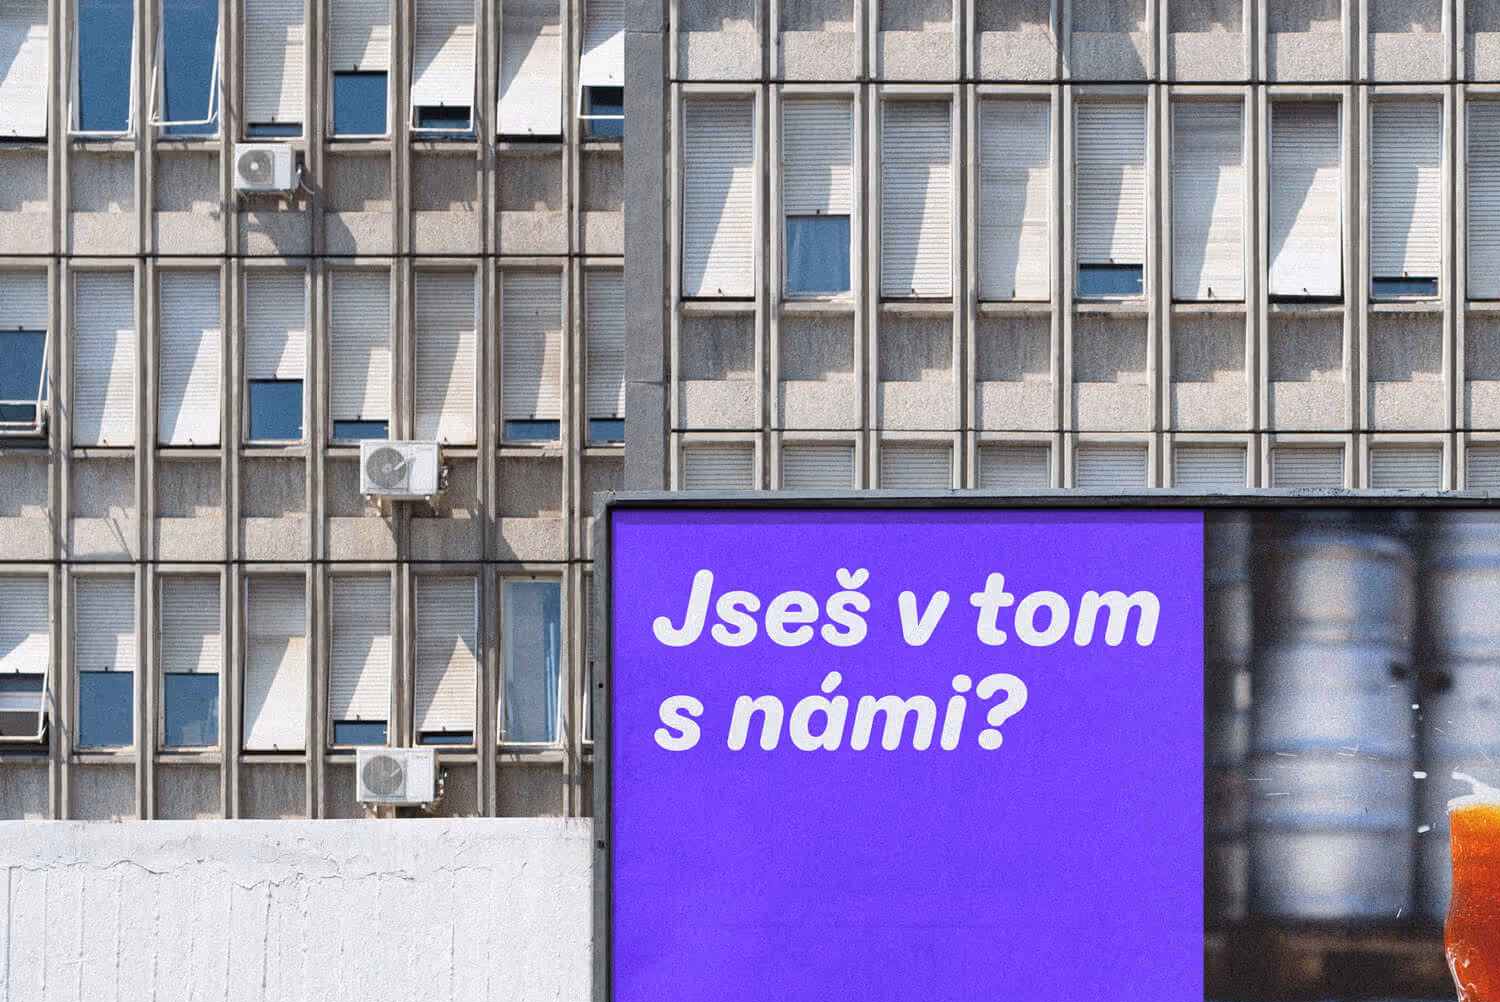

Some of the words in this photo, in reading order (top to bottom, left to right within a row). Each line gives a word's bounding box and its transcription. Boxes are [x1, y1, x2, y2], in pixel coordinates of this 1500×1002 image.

[652, 567, 871, 647] Jseš
[897, 590, 950, 647] v
[969, 572, 1161, 647] tom
[653, 695, 704, 752] s
[726, 671, 1028, 752] námi?
